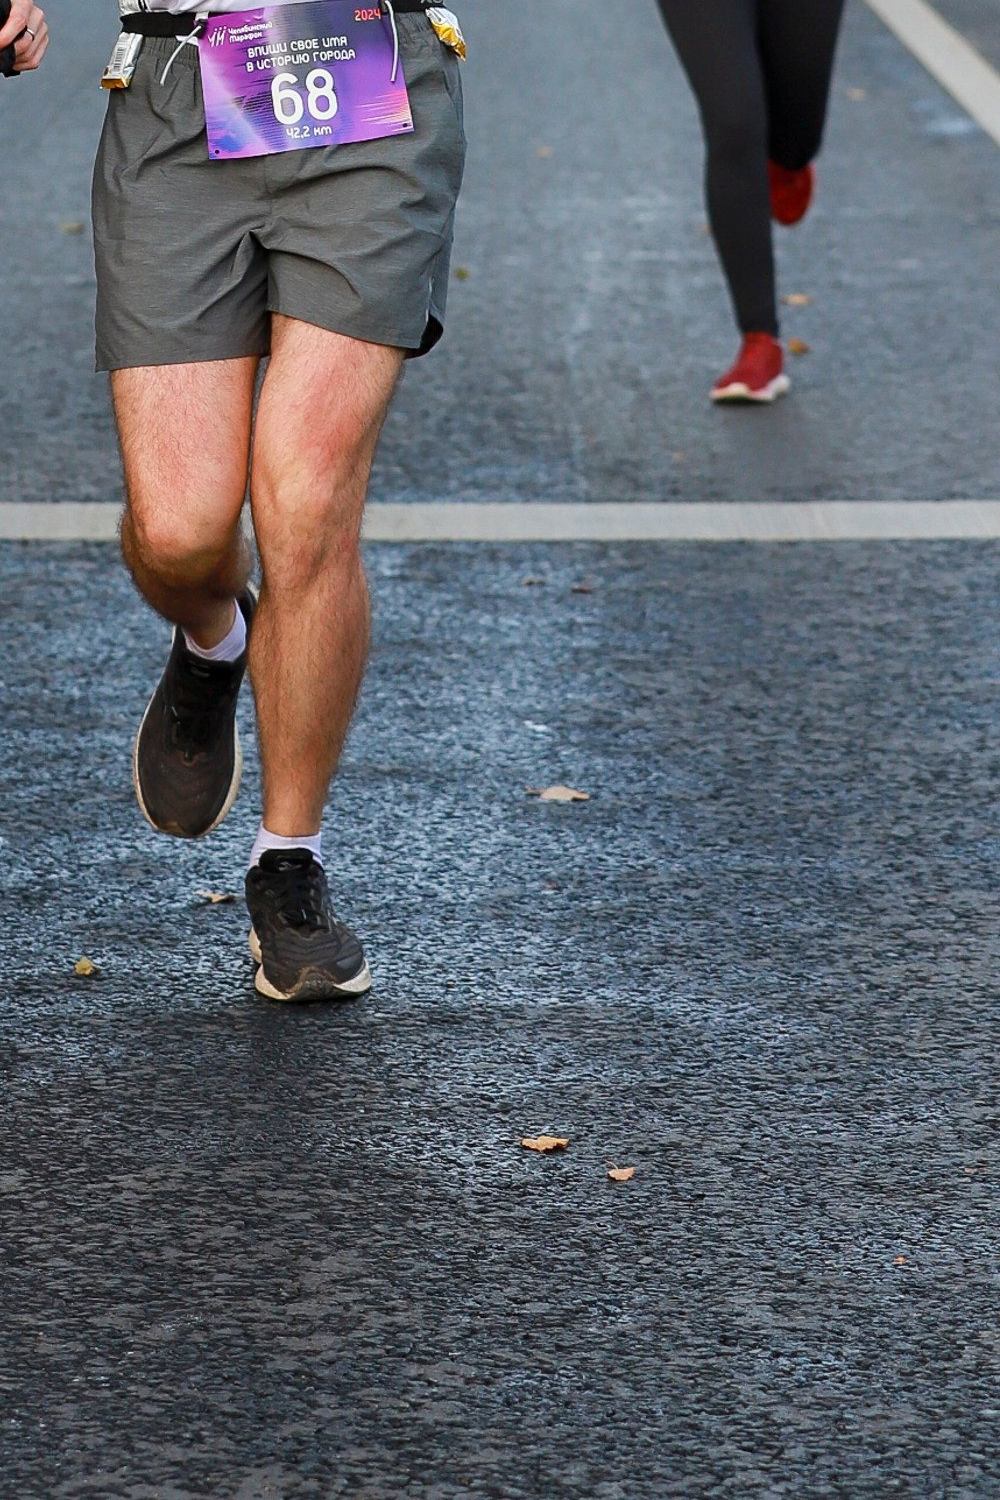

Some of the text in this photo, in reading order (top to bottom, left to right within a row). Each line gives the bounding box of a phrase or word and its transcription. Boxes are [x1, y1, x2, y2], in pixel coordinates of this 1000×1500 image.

[354, 7, 381, 22] 2024
[228, 21, 273, 35] Челябинский
[229, 31, 263, 43] Марафон
[247, 36, 348, 59] ВПИШИ СВОЕ ИМЯ
[246, 49, 356, 73] В ИСТОРИЮ ГОРОДА
[270, 68, 338, 125] 68
